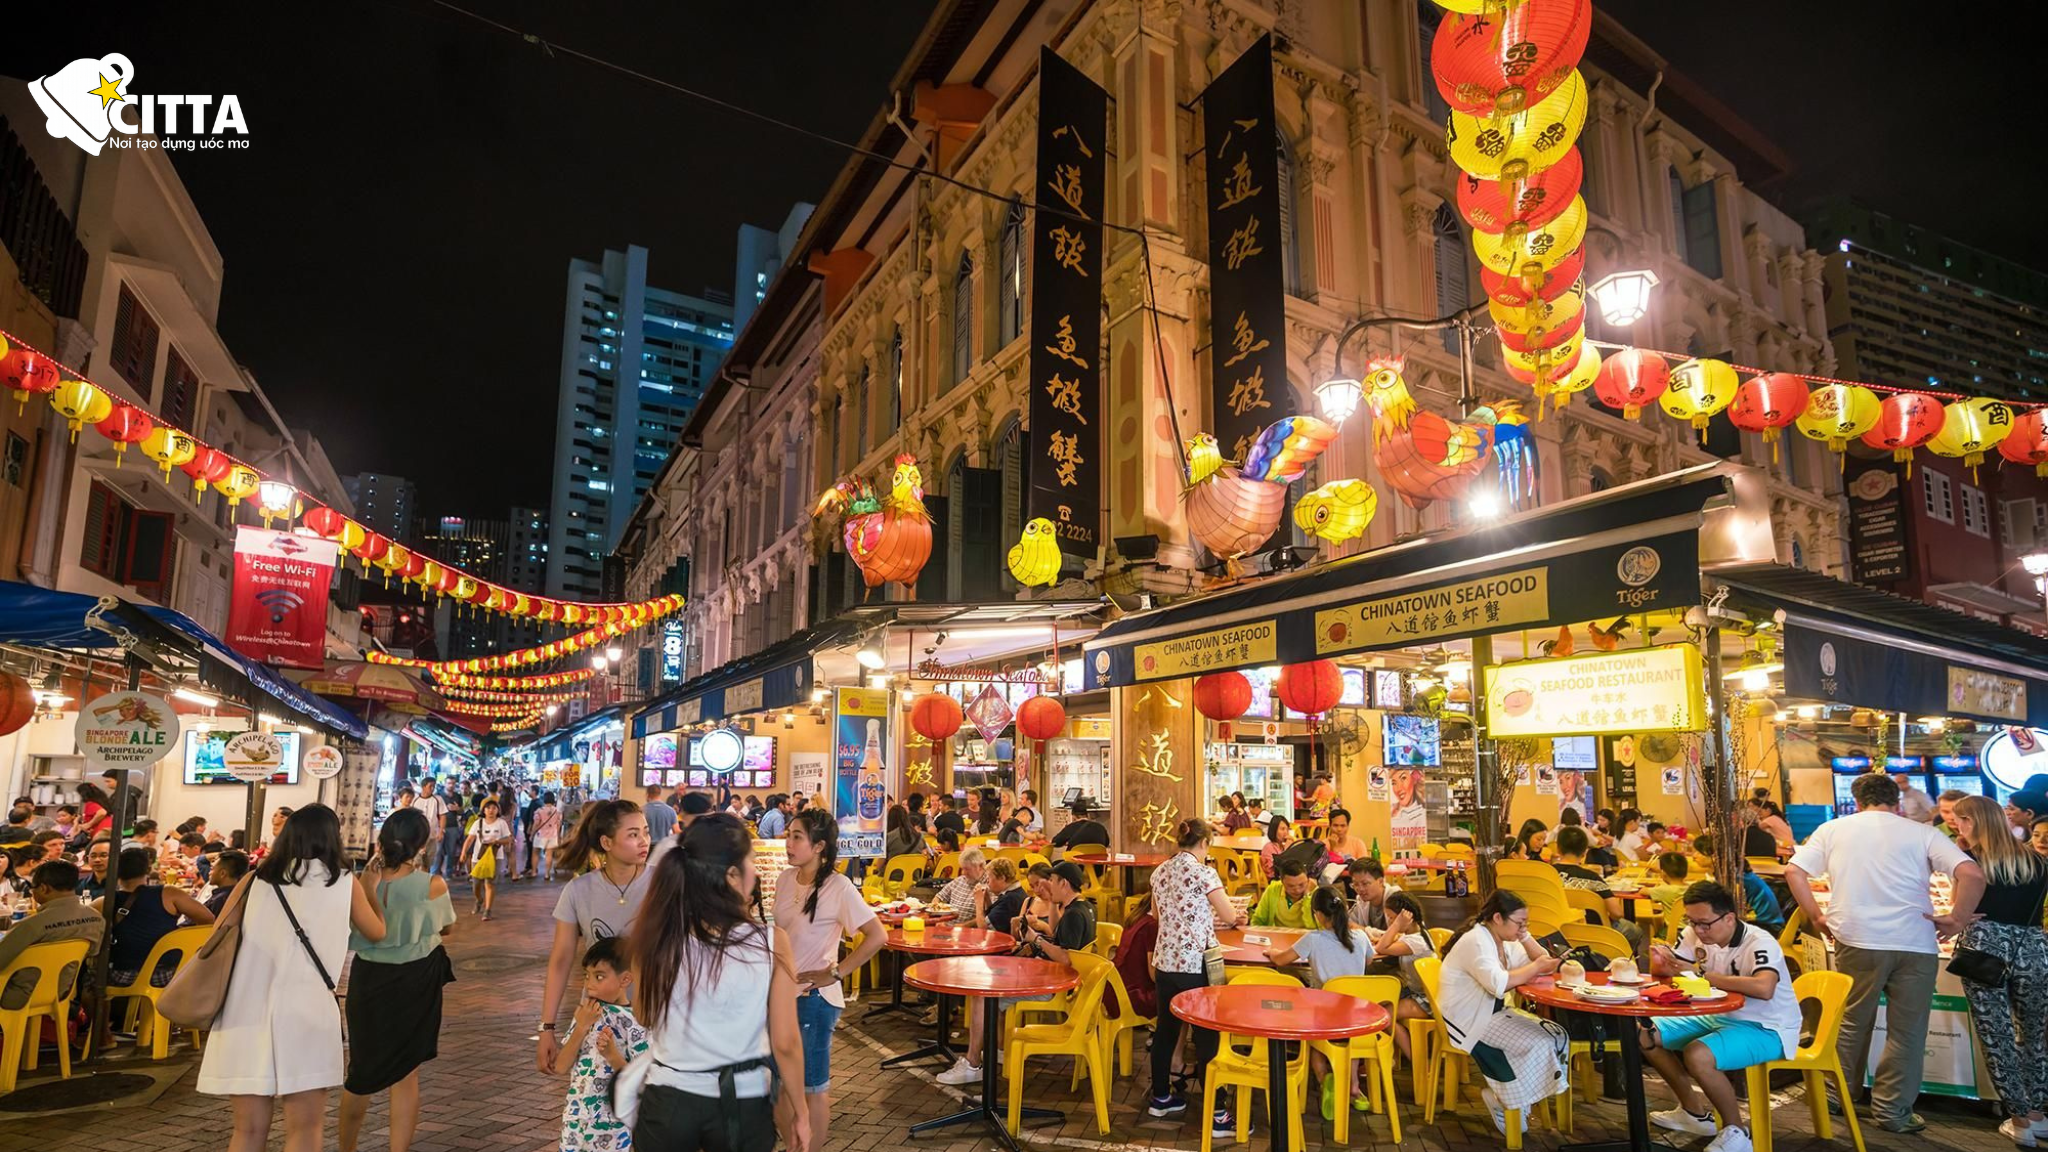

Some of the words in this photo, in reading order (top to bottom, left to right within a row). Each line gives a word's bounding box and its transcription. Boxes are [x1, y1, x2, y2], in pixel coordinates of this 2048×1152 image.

[1066, 524, 1092, 543] 2224
[252, 560, 281, 573] Free
[284, 563, 317, 578] Wi-Fi
[1865, 567, 1893, 578] LEVEL
[1894, 566, 1901, 574] 2
[1360, 590, 1451, 622] CHINATOWN
[1455, 575, 1537, 604] SEAFOOD
[1616, 587, 1659, 608] Tiger
[1163, 635, 1220, 656] CHINATOWN
[1222, 625, 1271, 646] SEAFOOD
[1569, 656, 1647, 676] CHINATOWN
[1540, 677, 1594, 693] SEAFOOD
[1597, 668, 1683, 688] RESTAURANT
[85, 736, 129, 745] BLONDE
[129, 730, 166, 745] ALE
[228, 734, 280, 755] ARCHIPELAGO
[97, 745, 154, 755] ARCHIPELAGO
[104, 753, 146, 762] BREWERY
[843, 758, 855, 768] BIG
[1391, 826, 1426, 837] SINGAPORE
[1753, 949, 1769, 965] 5
[1928, 1029, 1962, 1039] Restaurant
